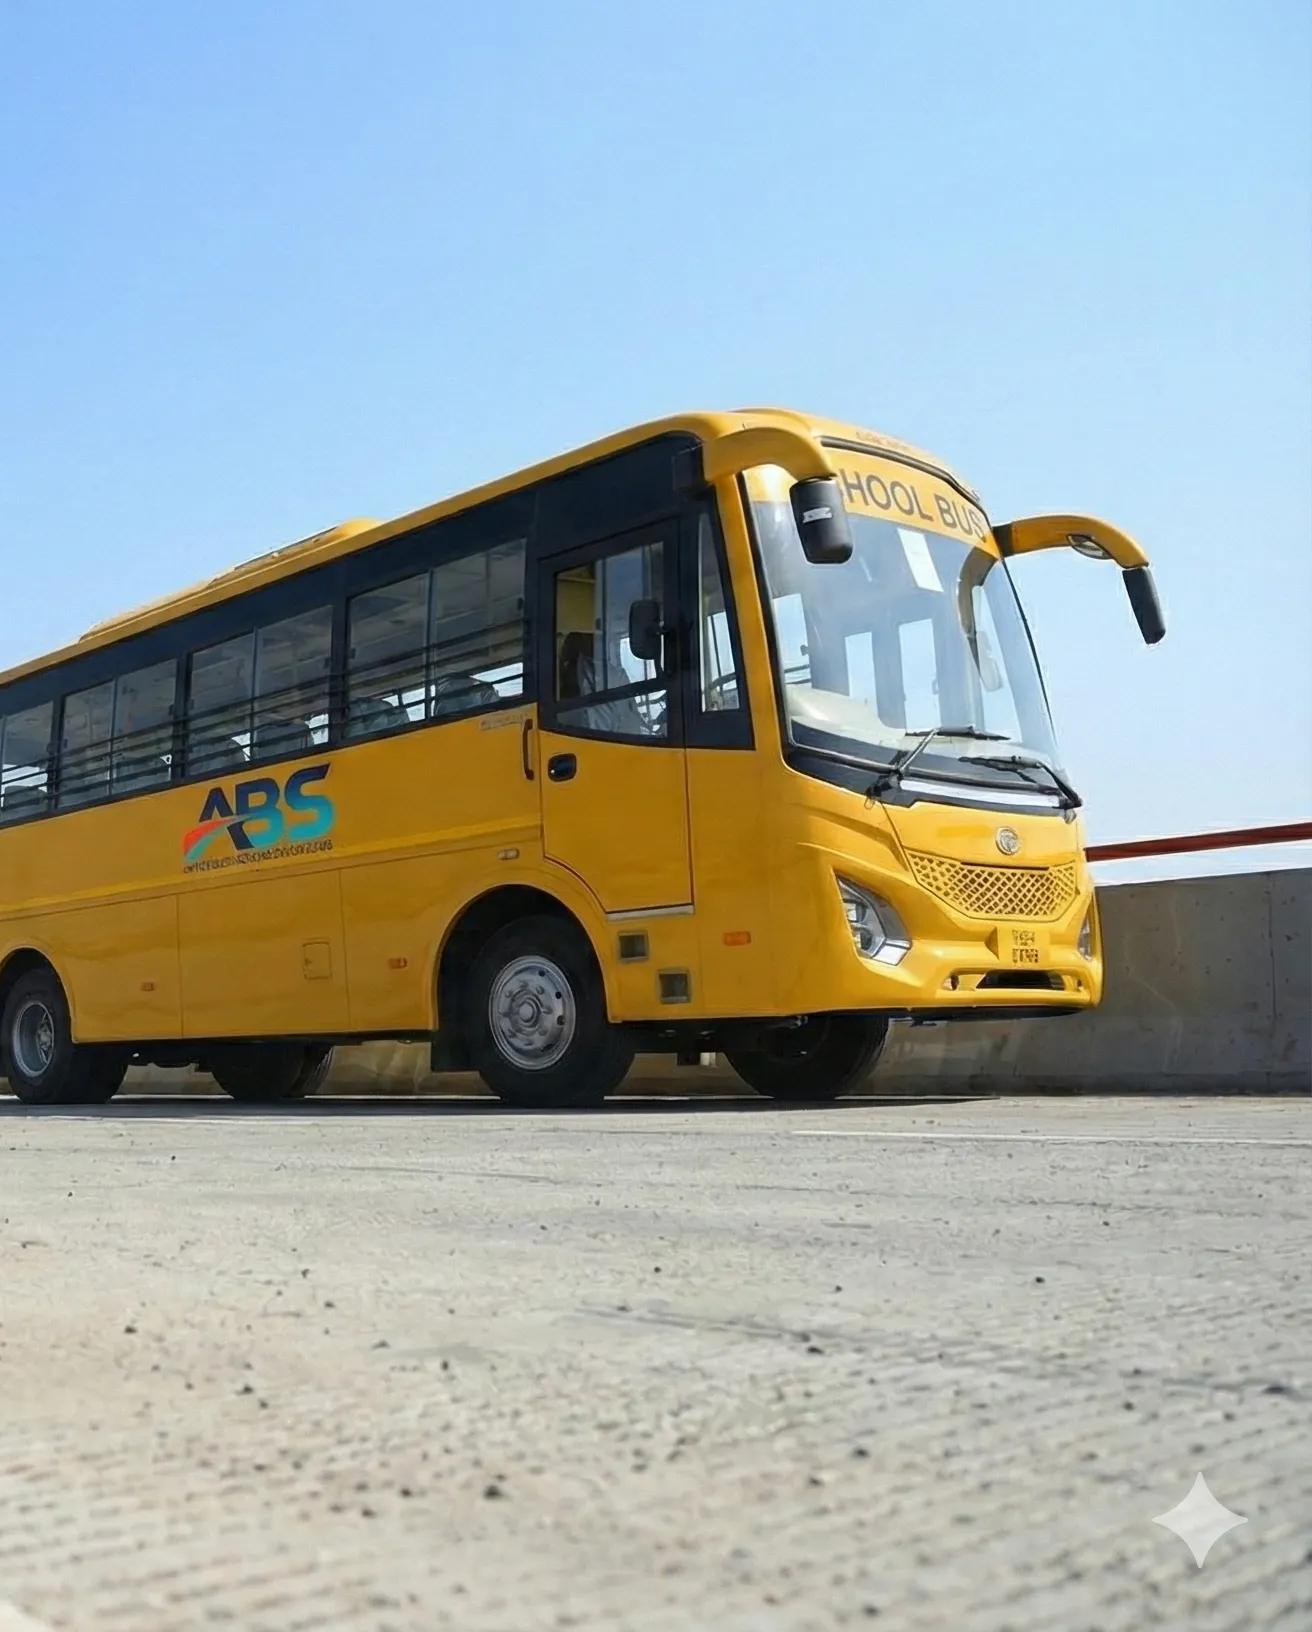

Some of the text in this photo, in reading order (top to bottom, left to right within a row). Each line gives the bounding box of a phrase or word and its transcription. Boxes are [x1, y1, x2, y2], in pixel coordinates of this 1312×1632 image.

[839, 468, 987, 544] HOOL BUS
[182, 763, 334, 863] ABS
